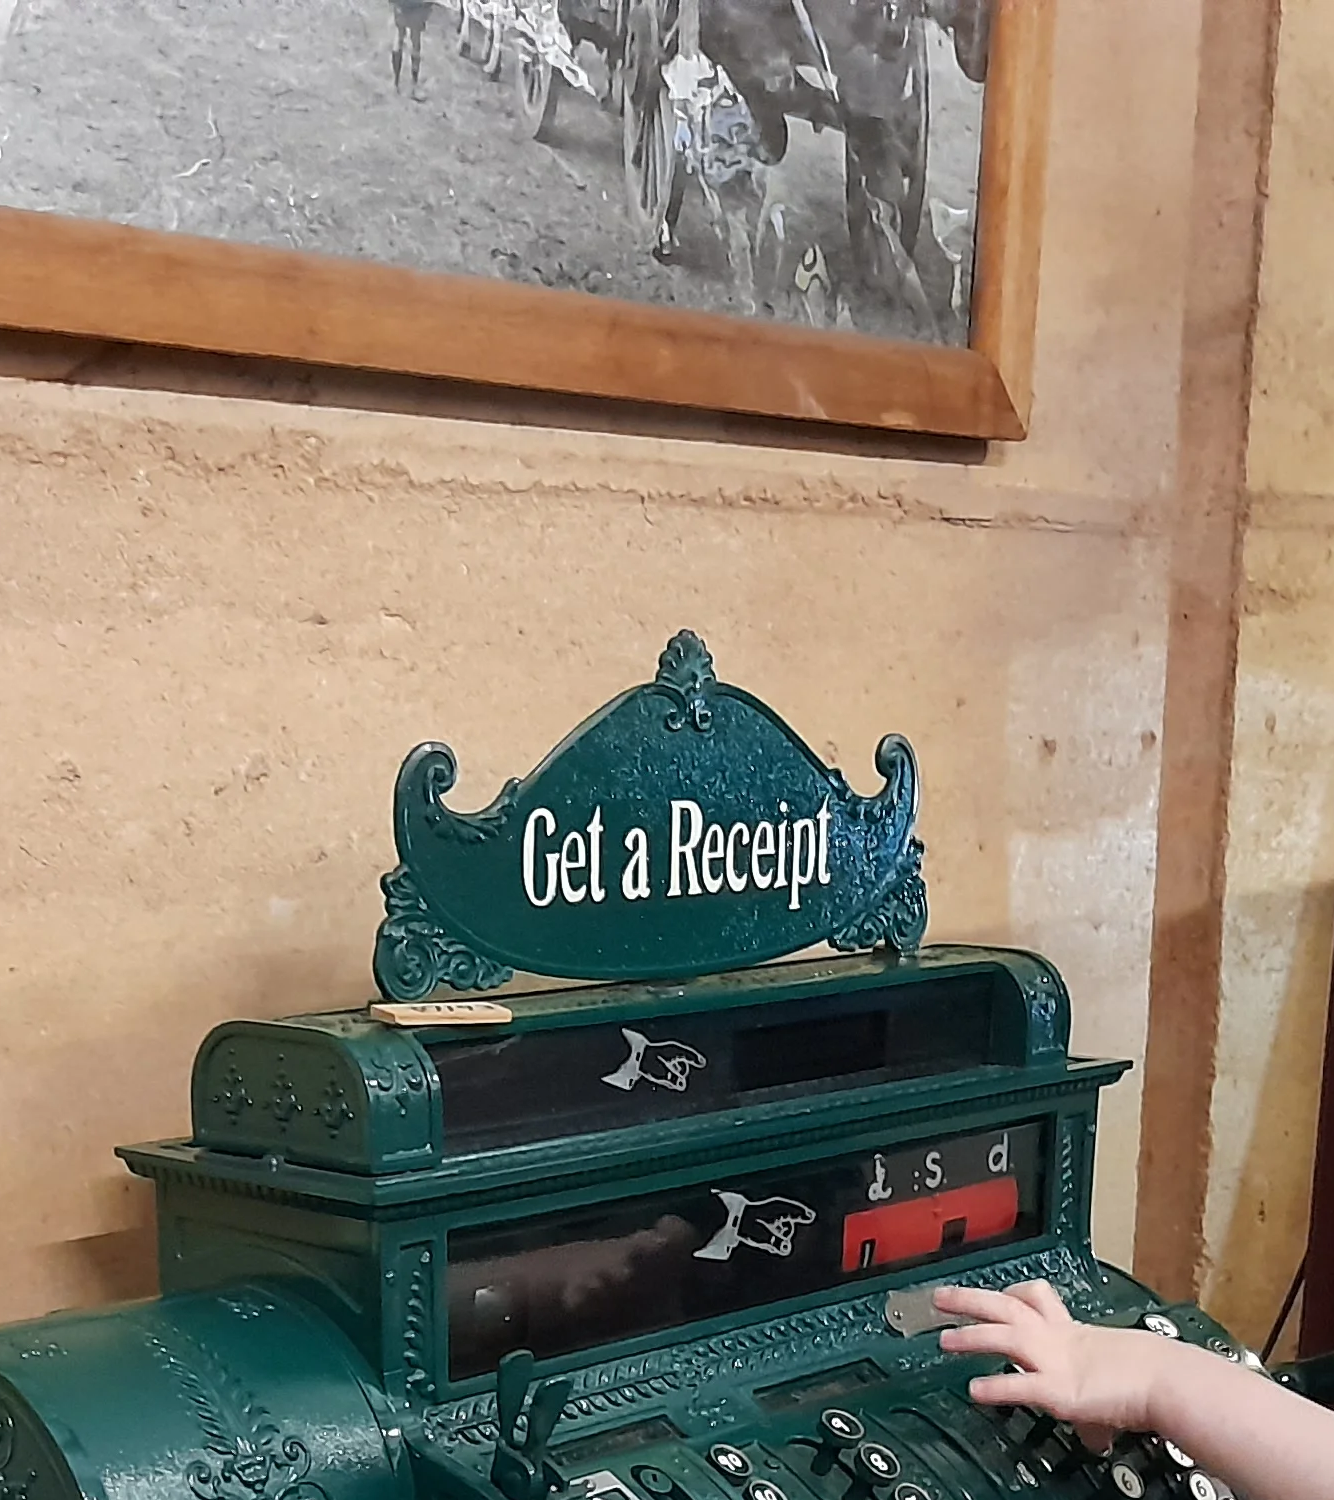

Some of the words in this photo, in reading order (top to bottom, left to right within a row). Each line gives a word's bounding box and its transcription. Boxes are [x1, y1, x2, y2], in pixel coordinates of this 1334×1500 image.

[522, 804, 605, 906] Get
[621, 825, 650, 900] a
[668, 799, 832, 909] Receipt
[830, 1416, 851, 1433] 9
[717, 1452, 743, 1471] 90
[869, 1452, 889, 1472] 8
[1121, 1473, 1133, 1491] 6
[1196, 1480, 1207, 1497] 6
